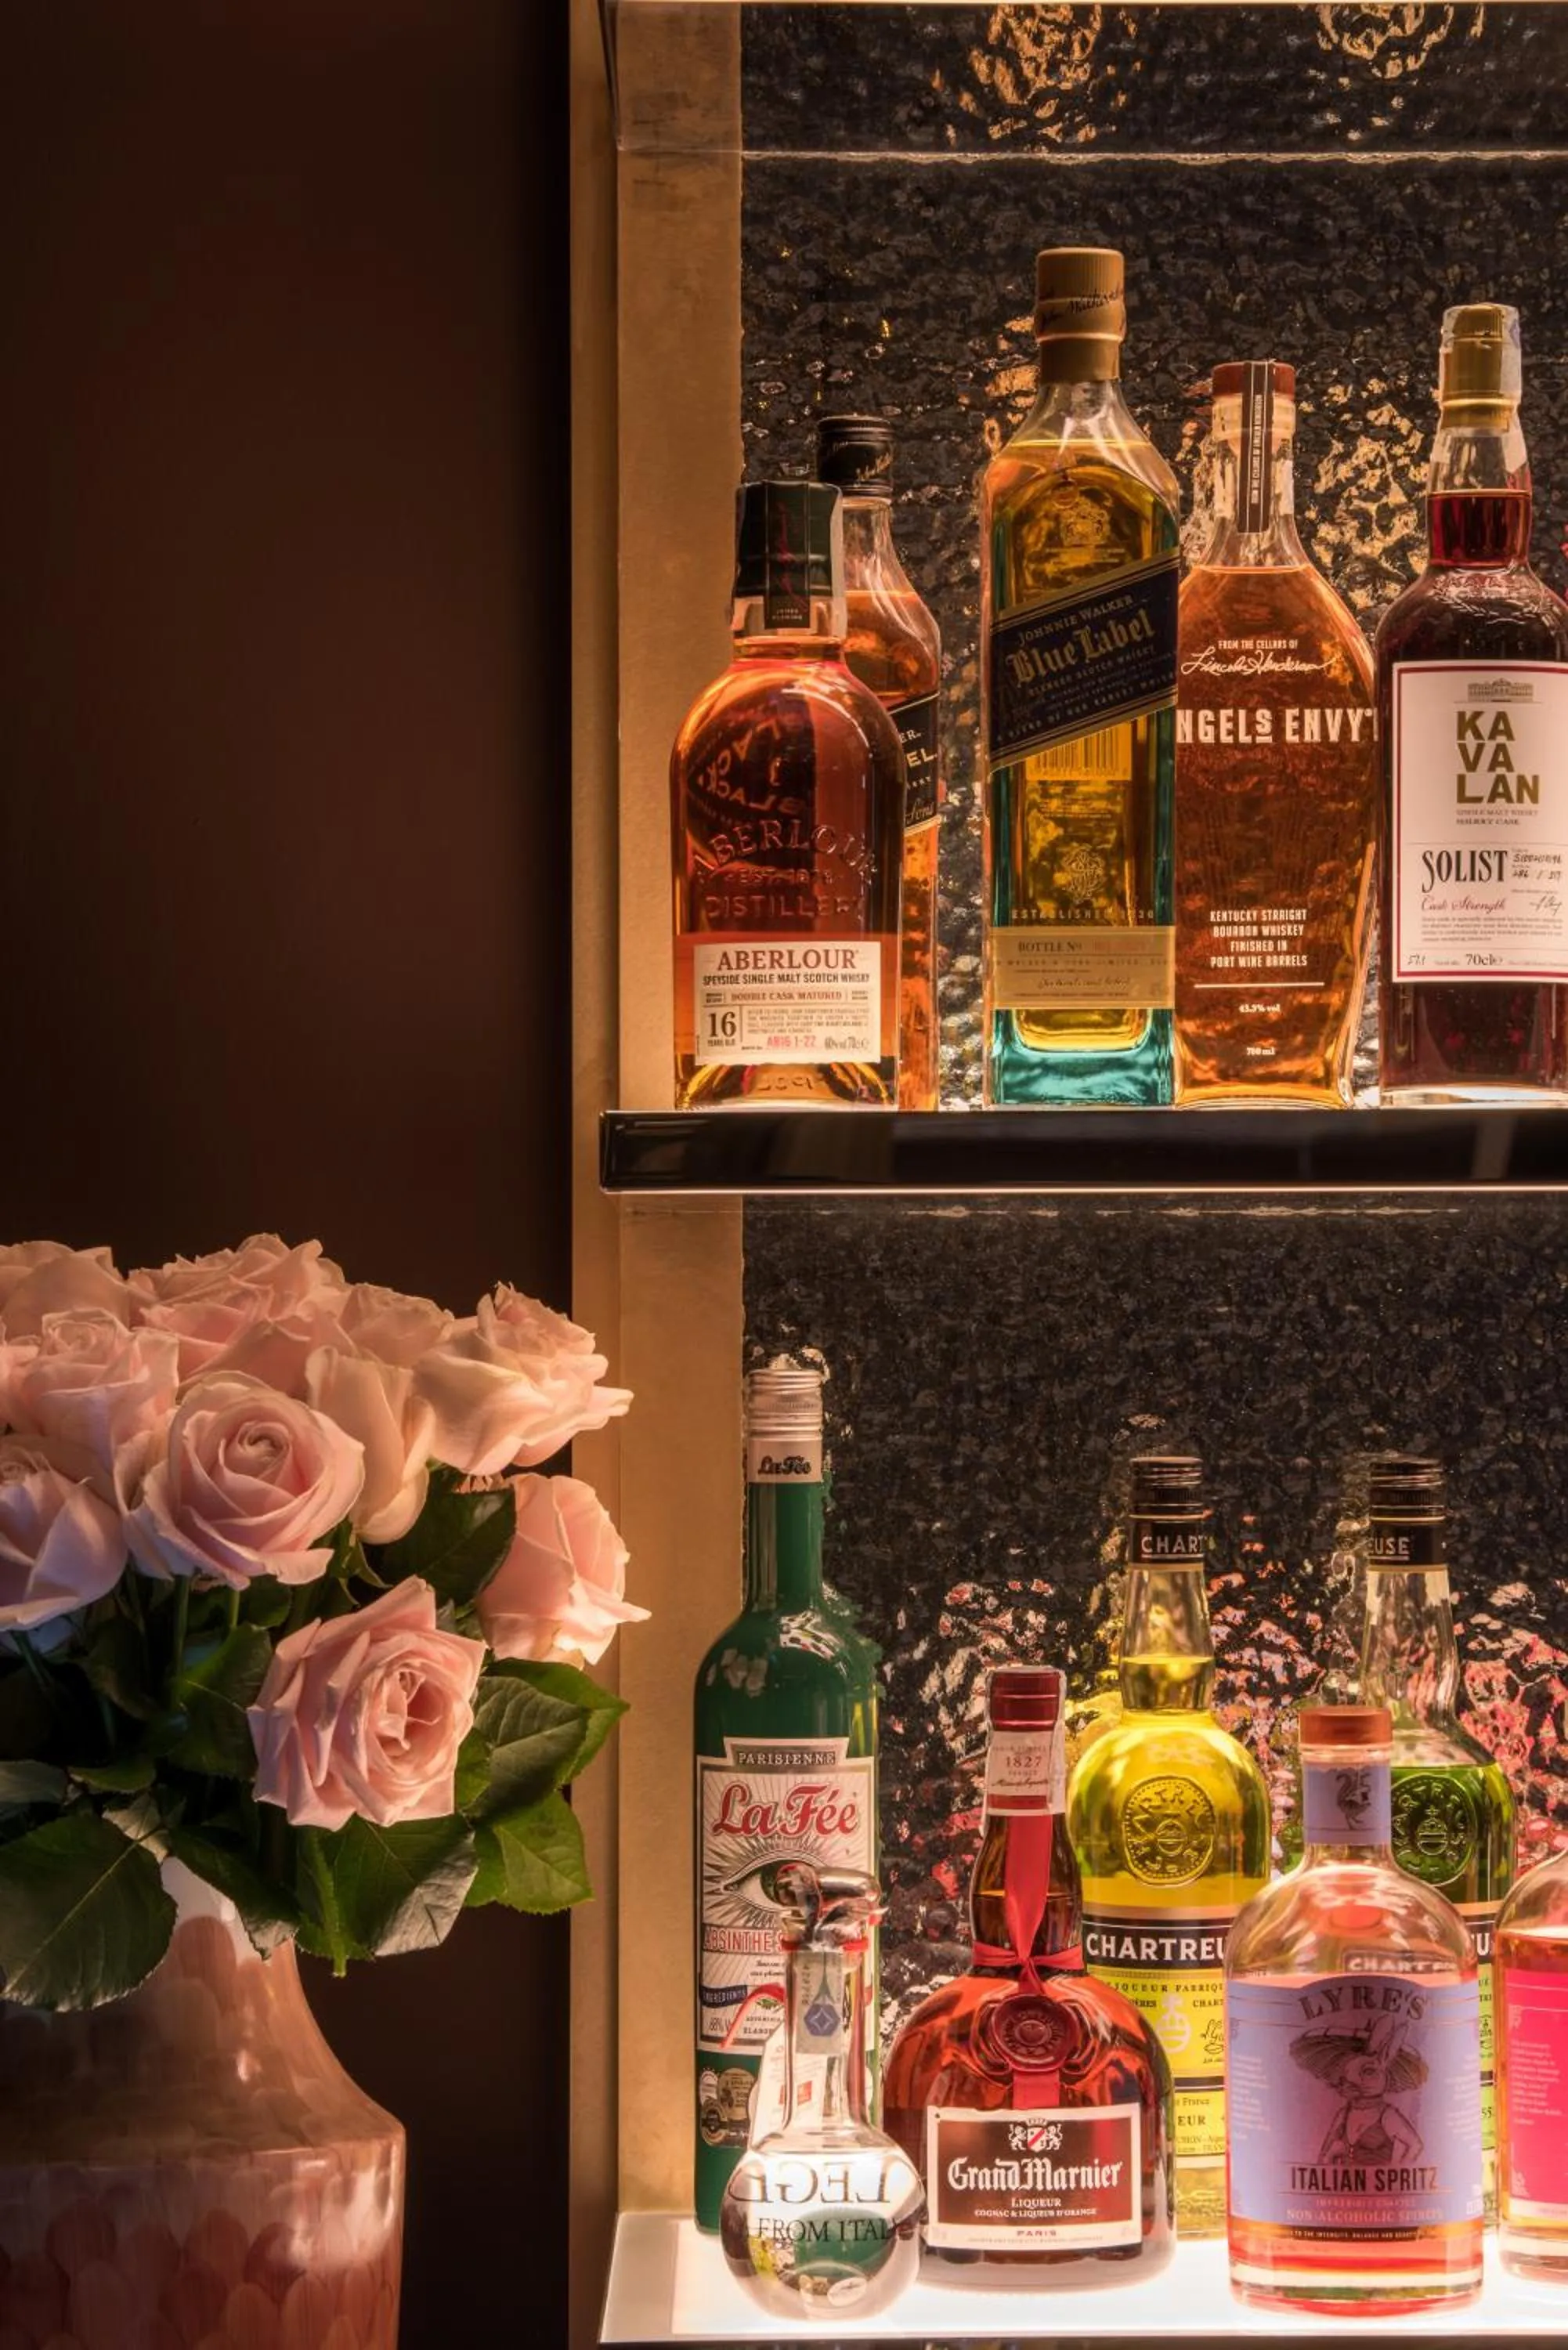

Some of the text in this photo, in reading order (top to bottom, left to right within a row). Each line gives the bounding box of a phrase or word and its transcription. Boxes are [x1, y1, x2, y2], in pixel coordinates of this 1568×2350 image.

[1218, 638, 1299, 649] FROM THE CELLARS OF
[1006, 641, 1078, 688] Blue
[1456, 710, 1516, 741] KA
[1456, 743, 1516, 772] VA
[1456, 774, 1540, 804] LAN
[1422, 850, 1508, 893] SOLIST
[1210, 909, 1307, 922] KENTUCKY STRAIGHT
[1213, 924, 1304, 938] BOURBON WHISKEY
[1230, 940, 1288, 953] FINISHED IN
[717, 949, 857, 971] ABERLOUR
[1210, 955, 1308, 968] PORT WINE BARRELS
[703, 972, 870, 986] SPEYSIDE SINGLE MALT SCOTCH WHISKY
[731, 992, 767, 1001] DOUBLE
[769, 991, 795, 1001] CASK
[798, 990, 843, 1000] MATURED
[708, 1011, 737, 1038] 16
[739, 1751, 836, 1766] PARISIENNE
[711, 1781, 858, 1836] La Fée
[1107, 1982, 1169, 1993] IQUEUR
[1298, 1986, 1427, 2021] LYRE'S
[948, 2157, 1124, 2191] Grand Marnier
[1291, 2166, 1439, 2192] ITALIAN SPRITZ
[1011, 2197, 1061, 2209] LIQUEUR
[757, 2218, 829, 2243] FROM
